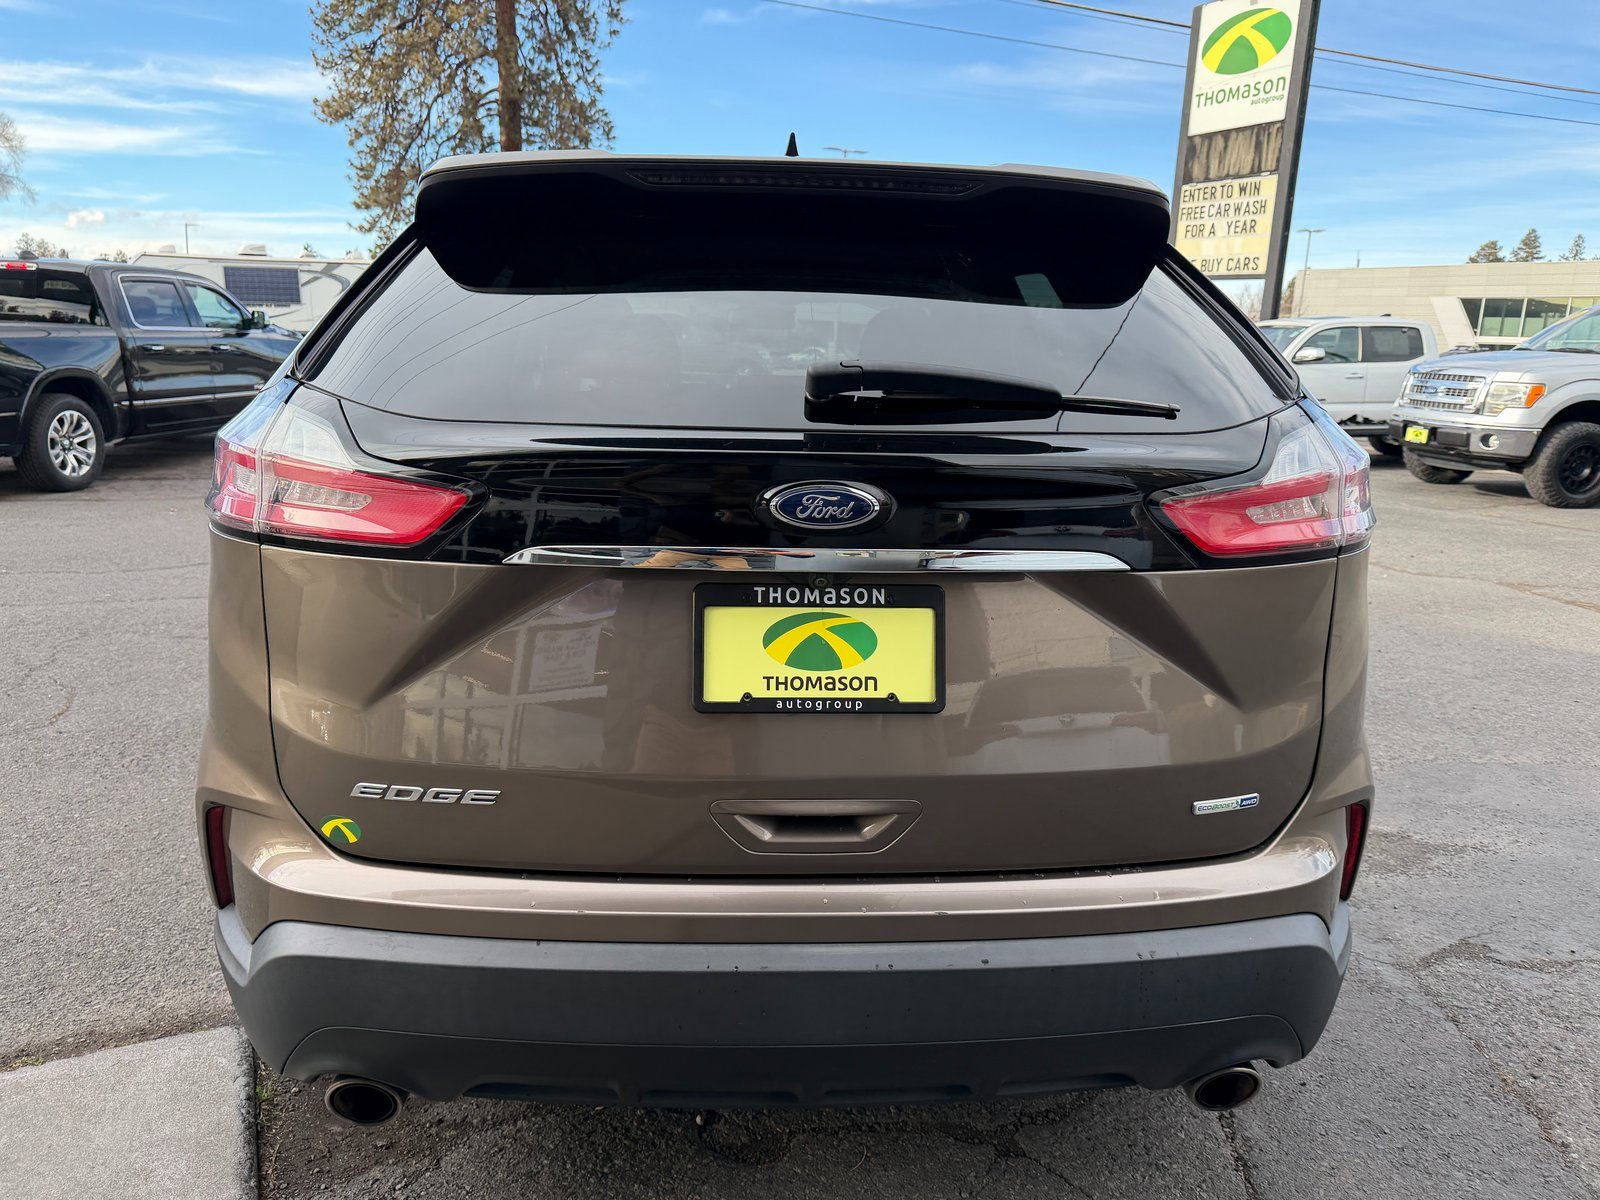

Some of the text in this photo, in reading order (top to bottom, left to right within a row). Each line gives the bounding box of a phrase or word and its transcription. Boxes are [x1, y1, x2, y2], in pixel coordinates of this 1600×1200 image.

[1250, 93, 1285, 106] autogroup
[1182, 181, 1261, 203] ENTER TO WIN
[1180, 200, 1267, 221] FREE CAR WASH
[1184, 219, 1257, 239] FOR A YEAR
[1200, 258, 1223, 273] BUY
[1226, 256, 1260, 272] CARS
[795, 494, 855, 519] Ford
[776, 699, 863, 710] autogroup
[350, 782, 502, 806] EDGE
[1240, 798, 1257, 807] AWD
